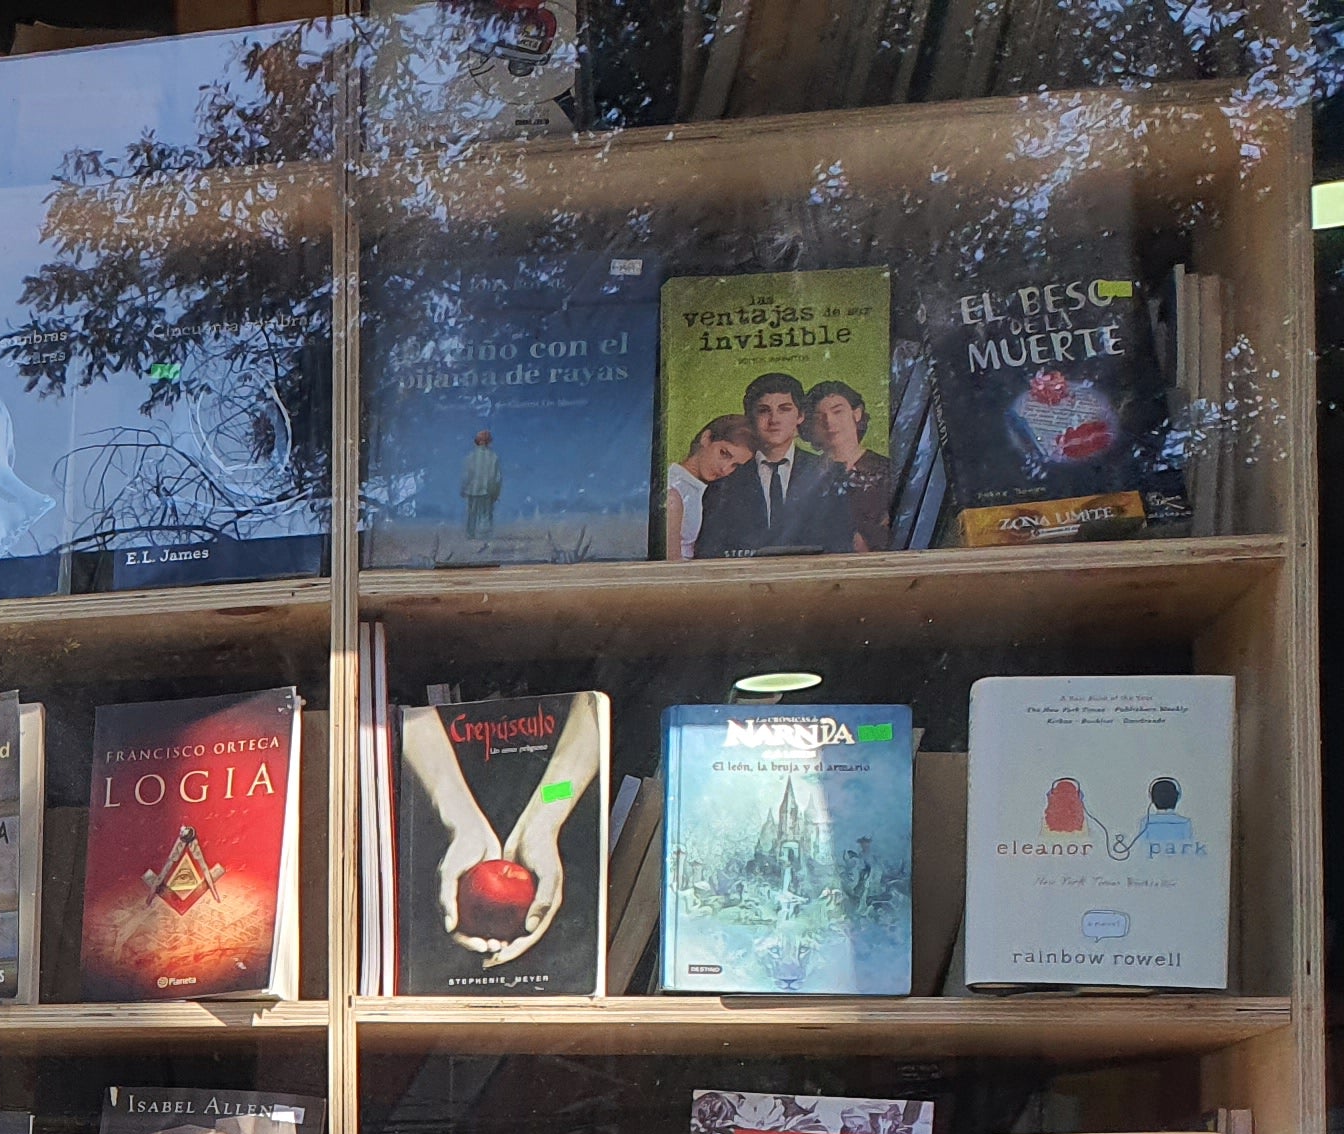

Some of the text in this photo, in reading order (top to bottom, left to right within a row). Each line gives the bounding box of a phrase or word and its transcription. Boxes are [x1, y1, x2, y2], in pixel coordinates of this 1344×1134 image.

[960, 292, 1006, 325] EL
[699, 325, 852, 351] invisible
[968, 324, 1126, 373] MUERTE
[450, 703, 556, 762] Crepúsculo
[105, 736, 280, 763] FRANCISCO ORTEGA
[103, 762, 275, 808] LOGIA
[1013, 949, 1181, 967] rainbow rowell
